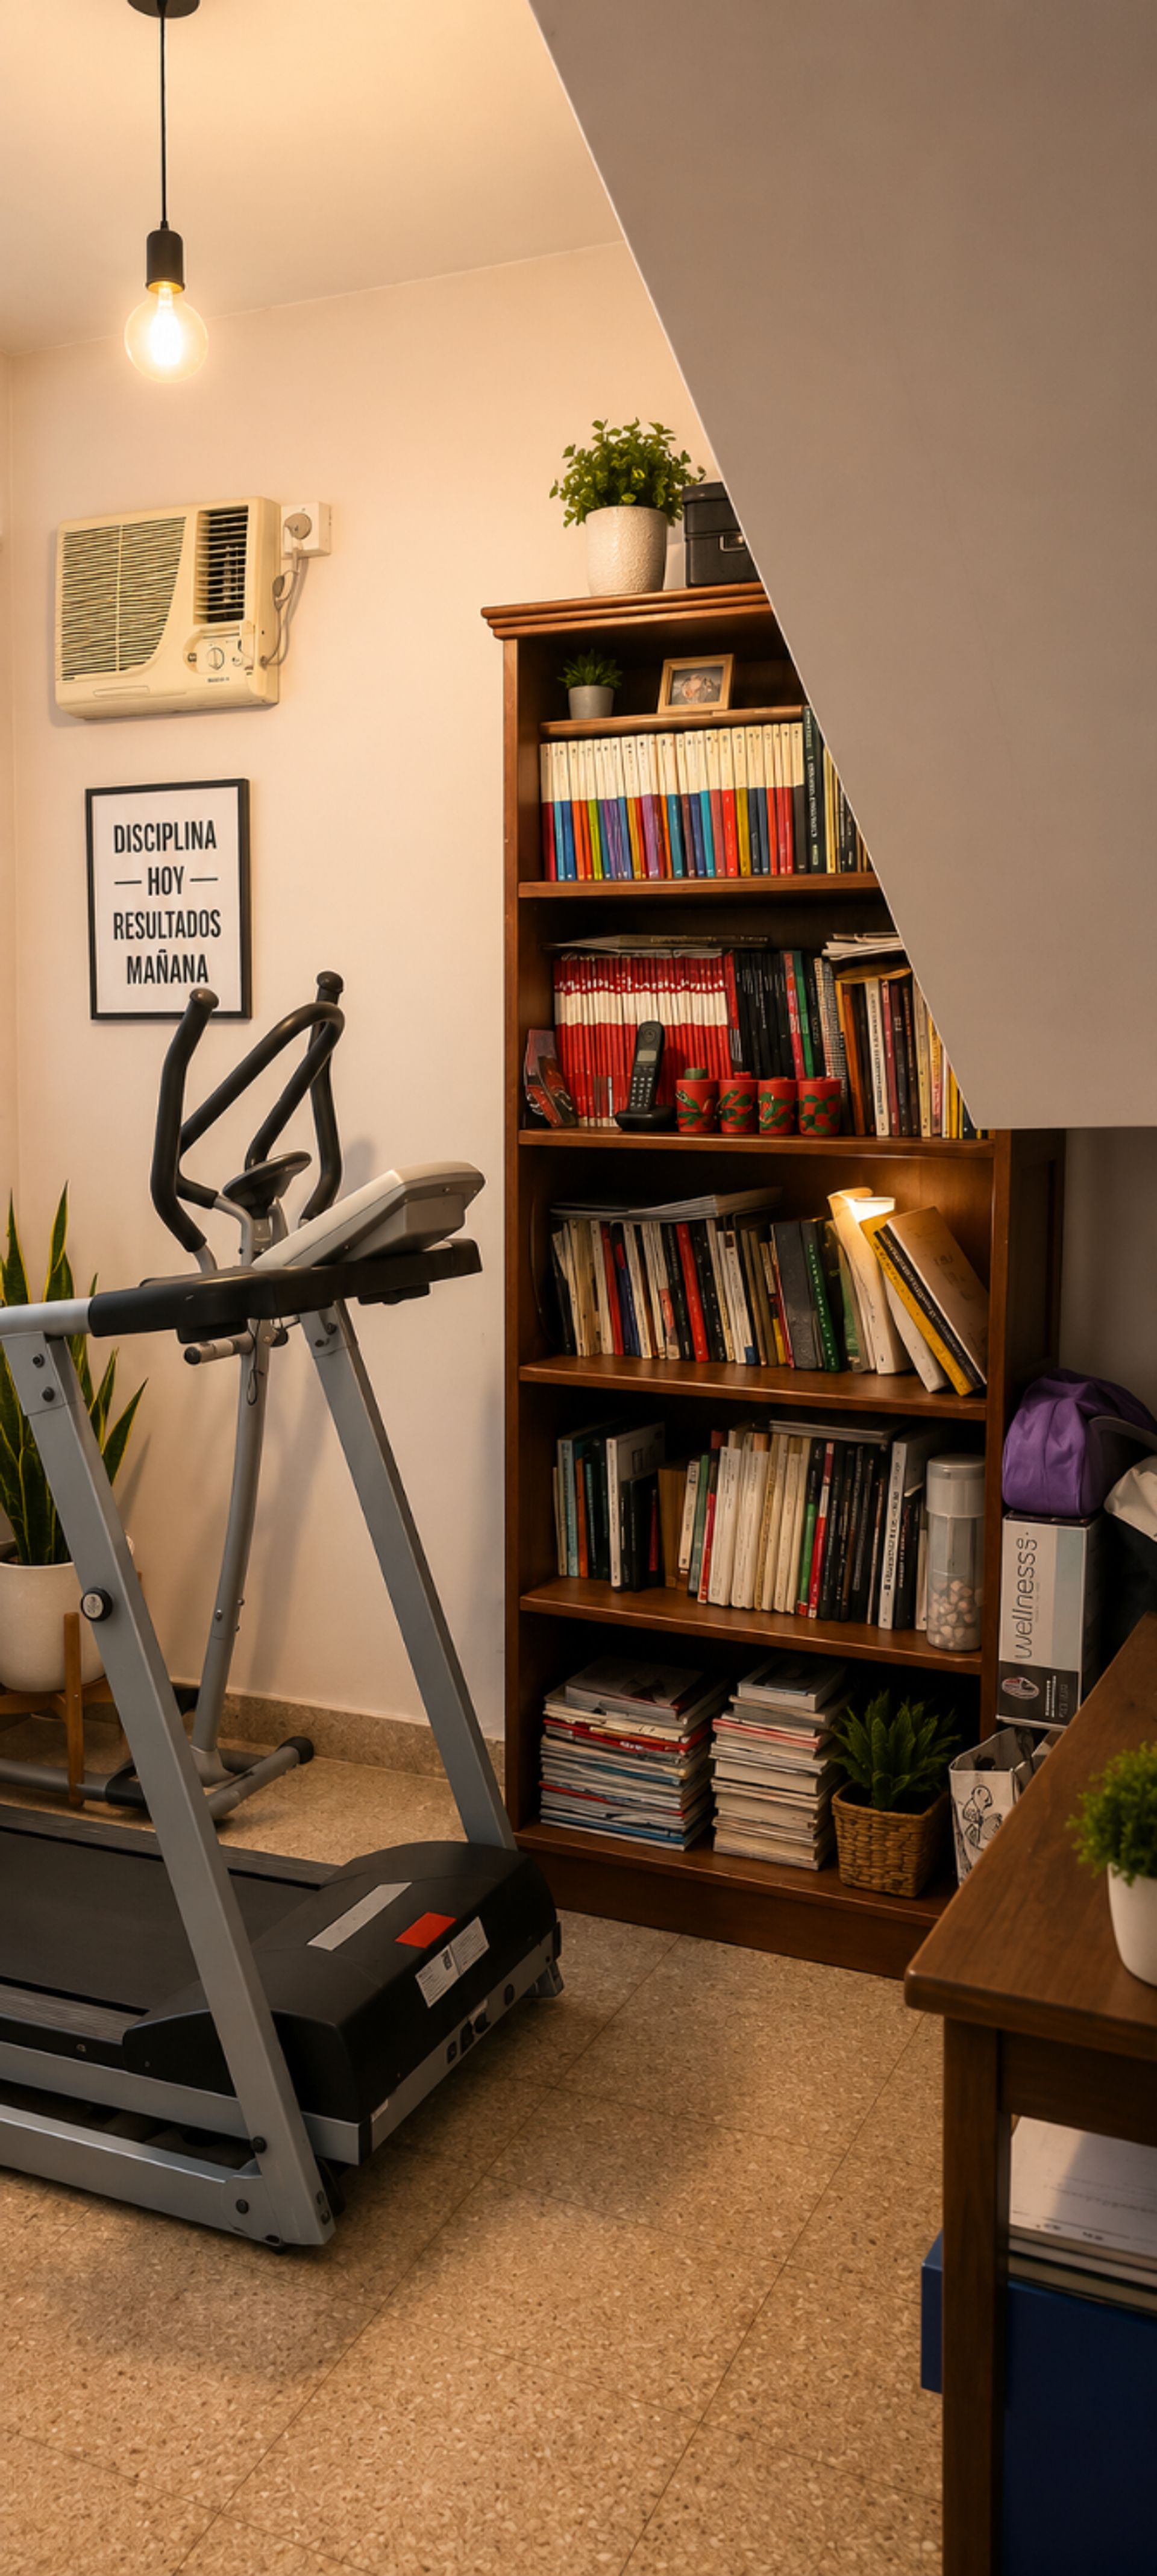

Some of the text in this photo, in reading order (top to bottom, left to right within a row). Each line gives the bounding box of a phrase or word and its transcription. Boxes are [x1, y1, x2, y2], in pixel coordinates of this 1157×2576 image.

[113, 820, 218, 853] DISCIPLINA
[147, 866, 185, 896] HOY
[113, 909, 222, 940] RESULTADOS
[127, 948, 209, 985] MAÑANA
